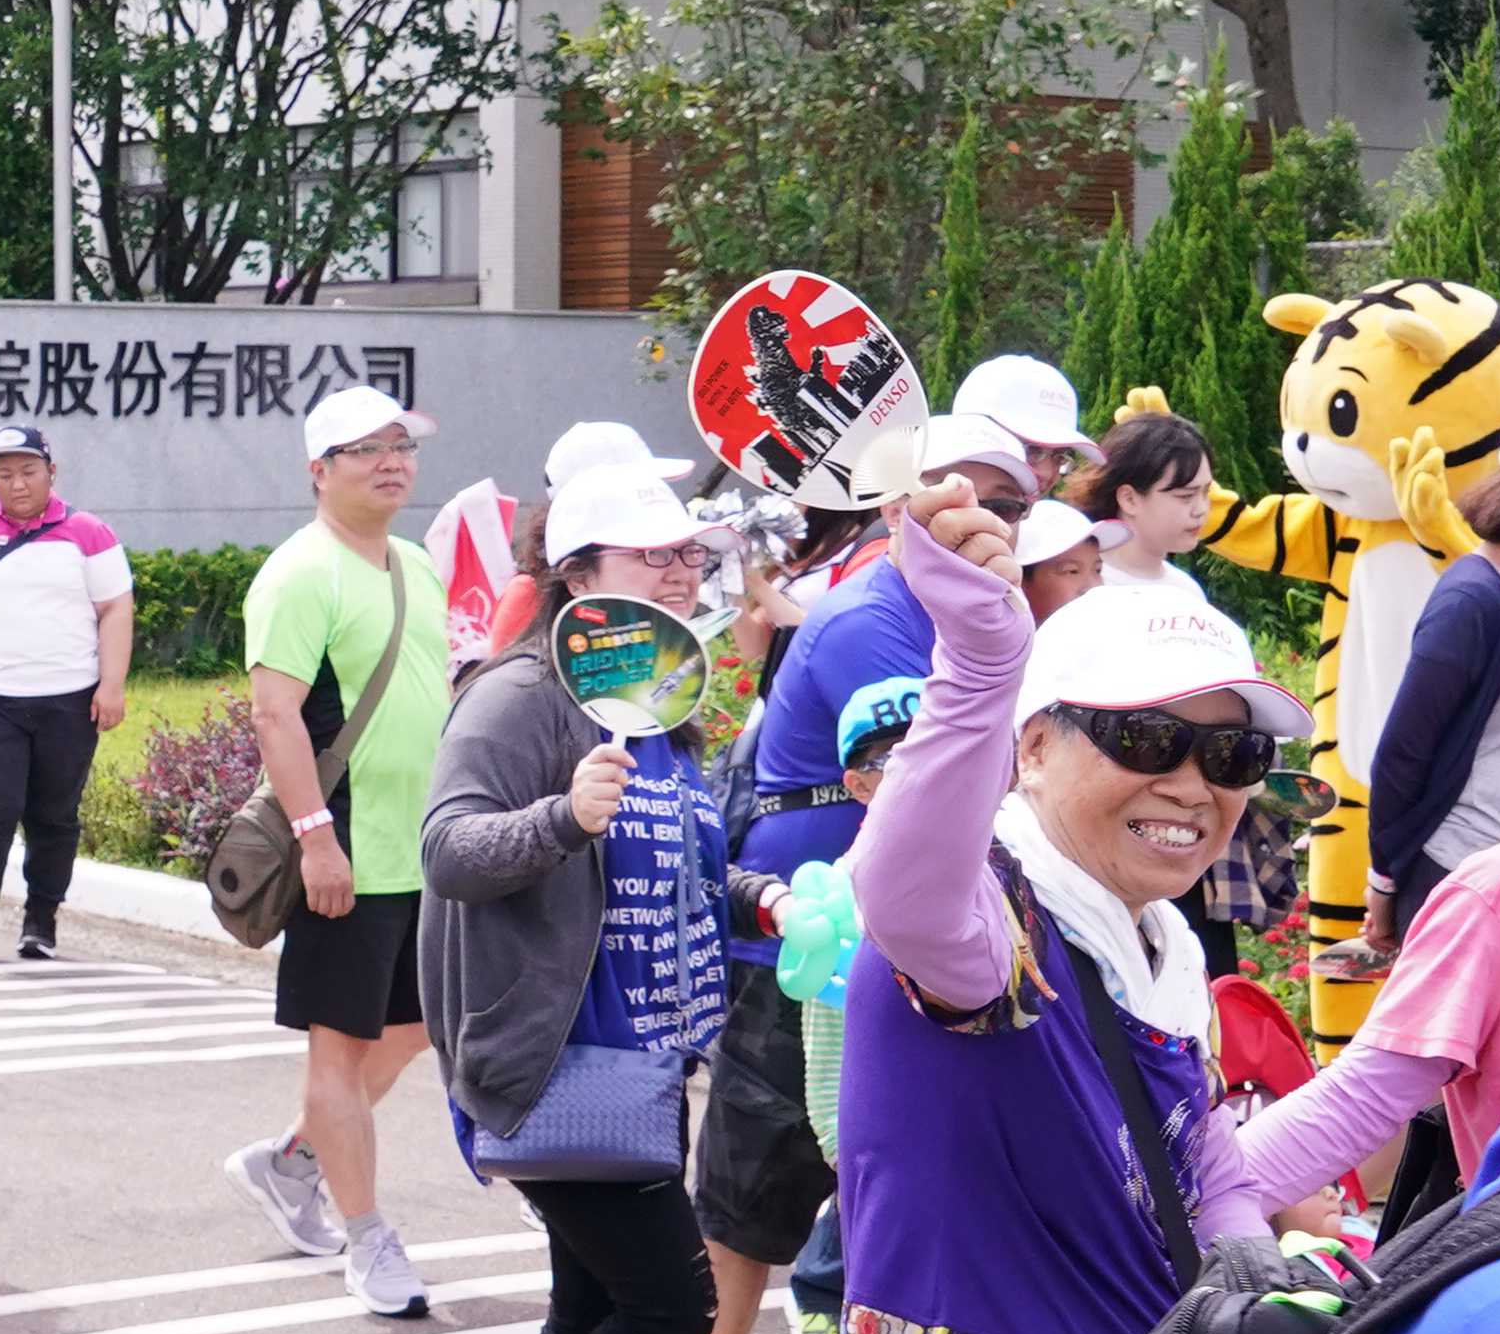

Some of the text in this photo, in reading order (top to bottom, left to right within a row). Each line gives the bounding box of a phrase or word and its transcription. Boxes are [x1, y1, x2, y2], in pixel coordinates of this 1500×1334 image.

[869, 377, 911, 427] DENSO
[1147, 615, 1232, 645] DENSO
[612, 878, 649, 895] YOU
